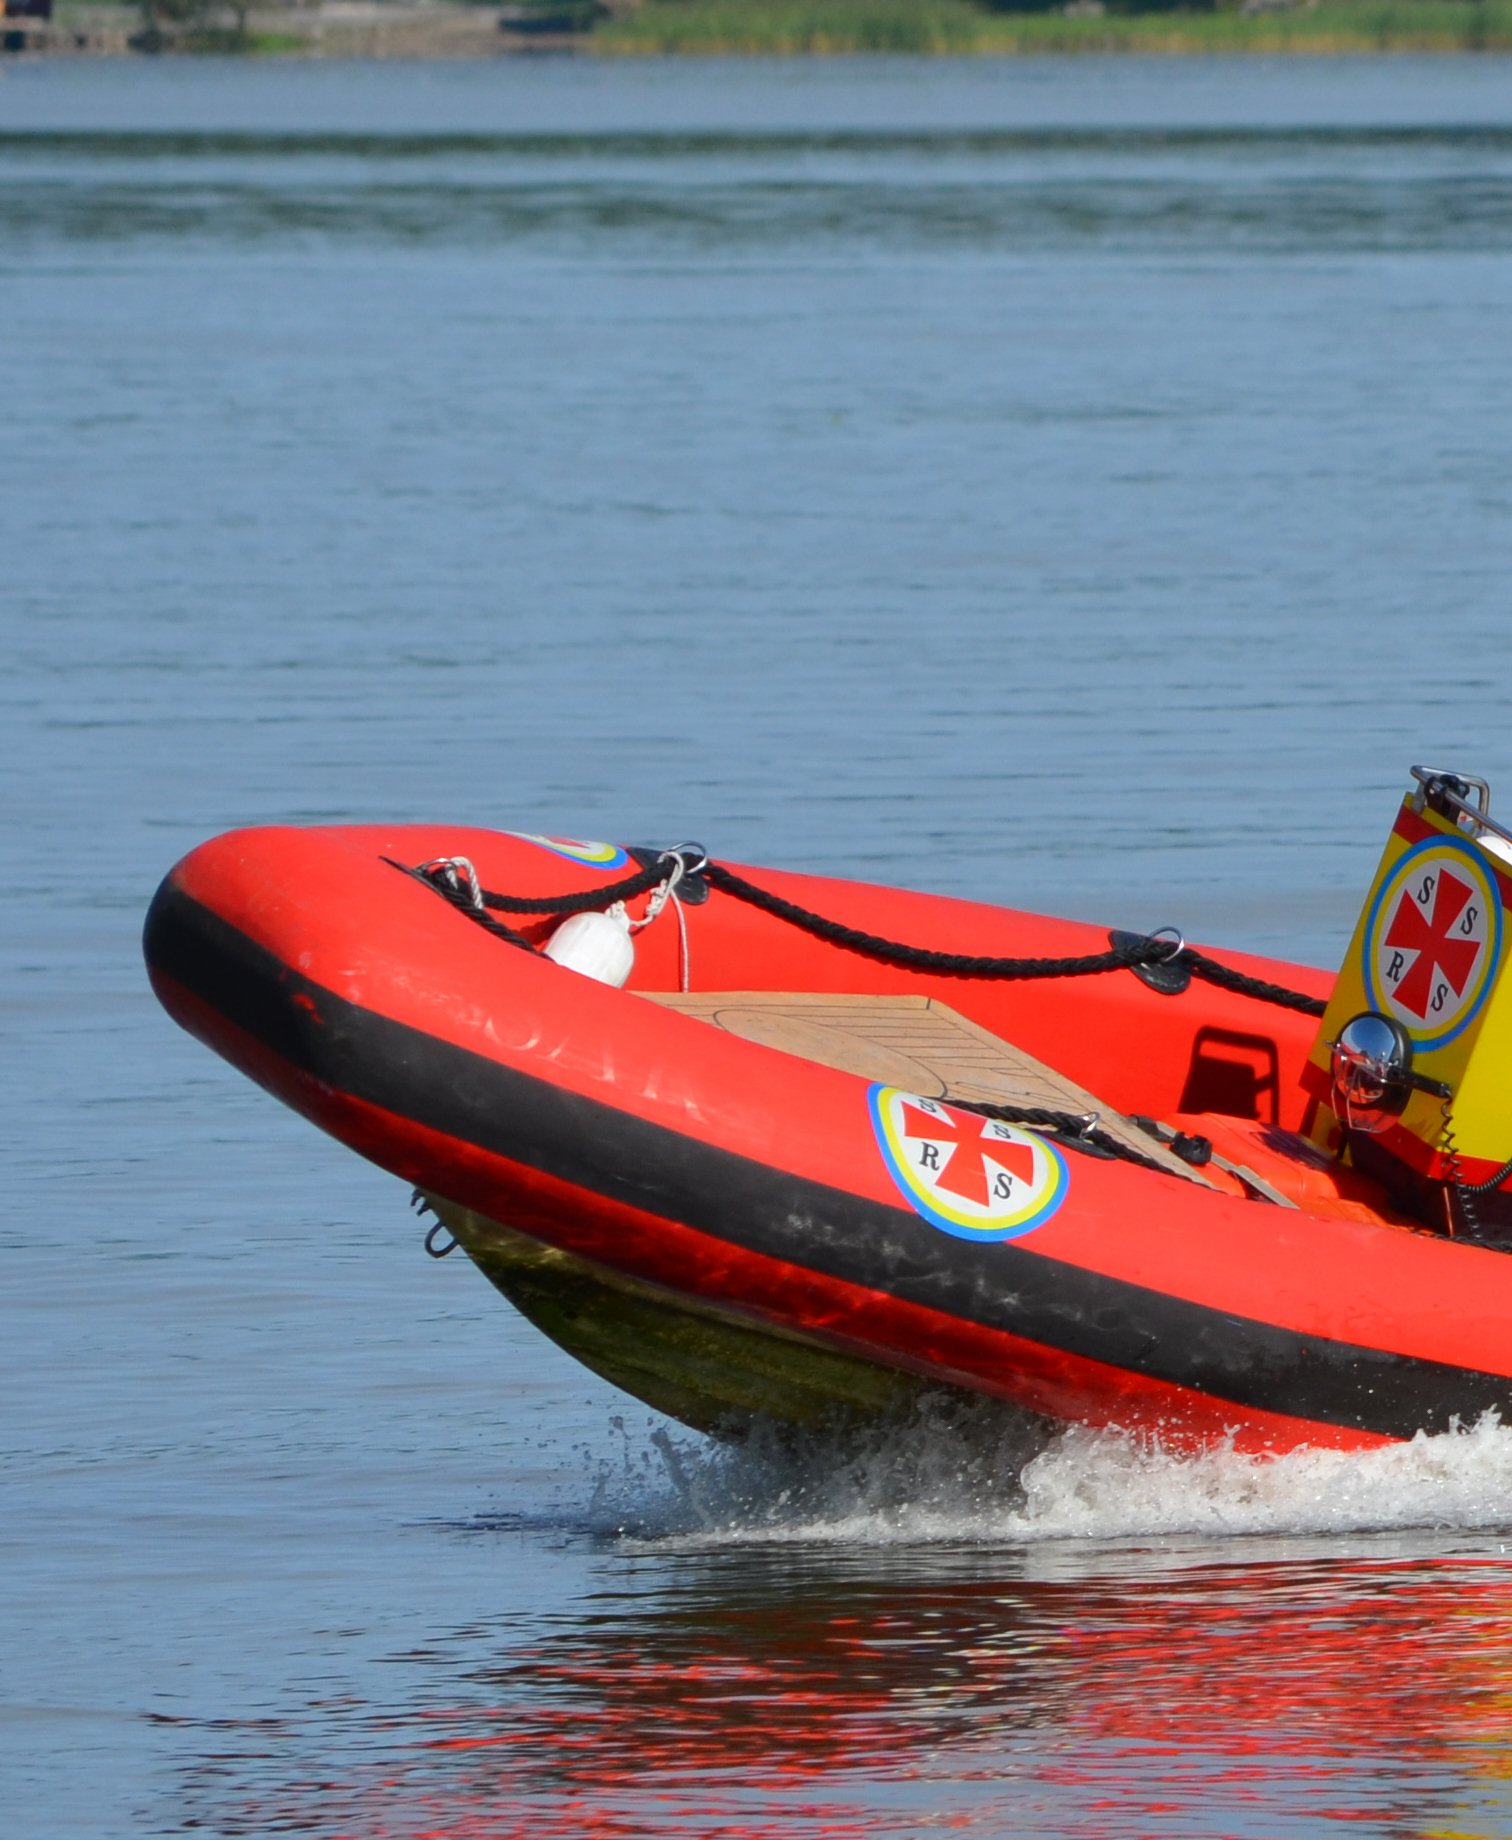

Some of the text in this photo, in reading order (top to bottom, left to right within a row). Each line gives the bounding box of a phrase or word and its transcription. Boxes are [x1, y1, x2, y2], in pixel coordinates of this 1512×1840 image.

[1417, 876, 1478, 935] S S
[1386, 951, 1448, 1011] R S
[918, 1099, 1011, 1139] S S
[919, 1141, 1013, 1199] R S
